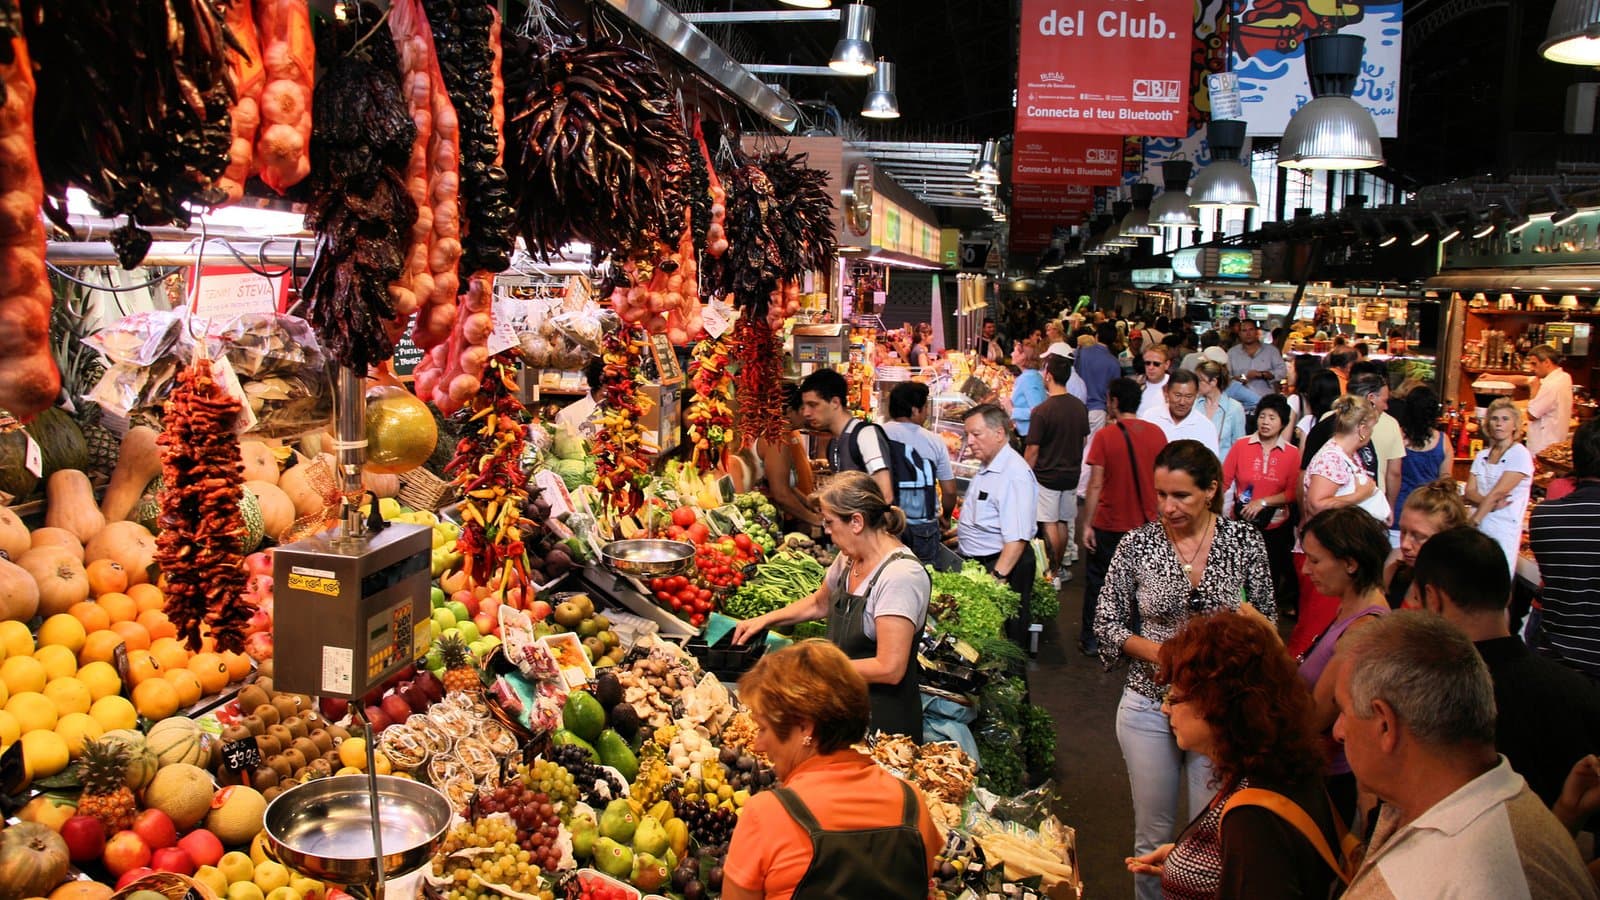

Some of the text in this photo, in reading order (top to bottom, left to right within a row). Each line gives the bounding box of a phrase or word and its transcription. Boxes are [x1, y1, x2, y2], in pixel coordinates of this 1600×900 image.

[1039, 9, 1176, 39] del Club.
[1027, 105, 1080, 118] Connecta
[1083, 107, 1093, 118] el
[1096, 107, 1115, 119] teu
[1017, 164, 1052, 174] Connecta
[1053, 166, 1061, 174] el
[1062, 166, 1075, 175] teu
[236, 282, 273, 298] STEVIA
